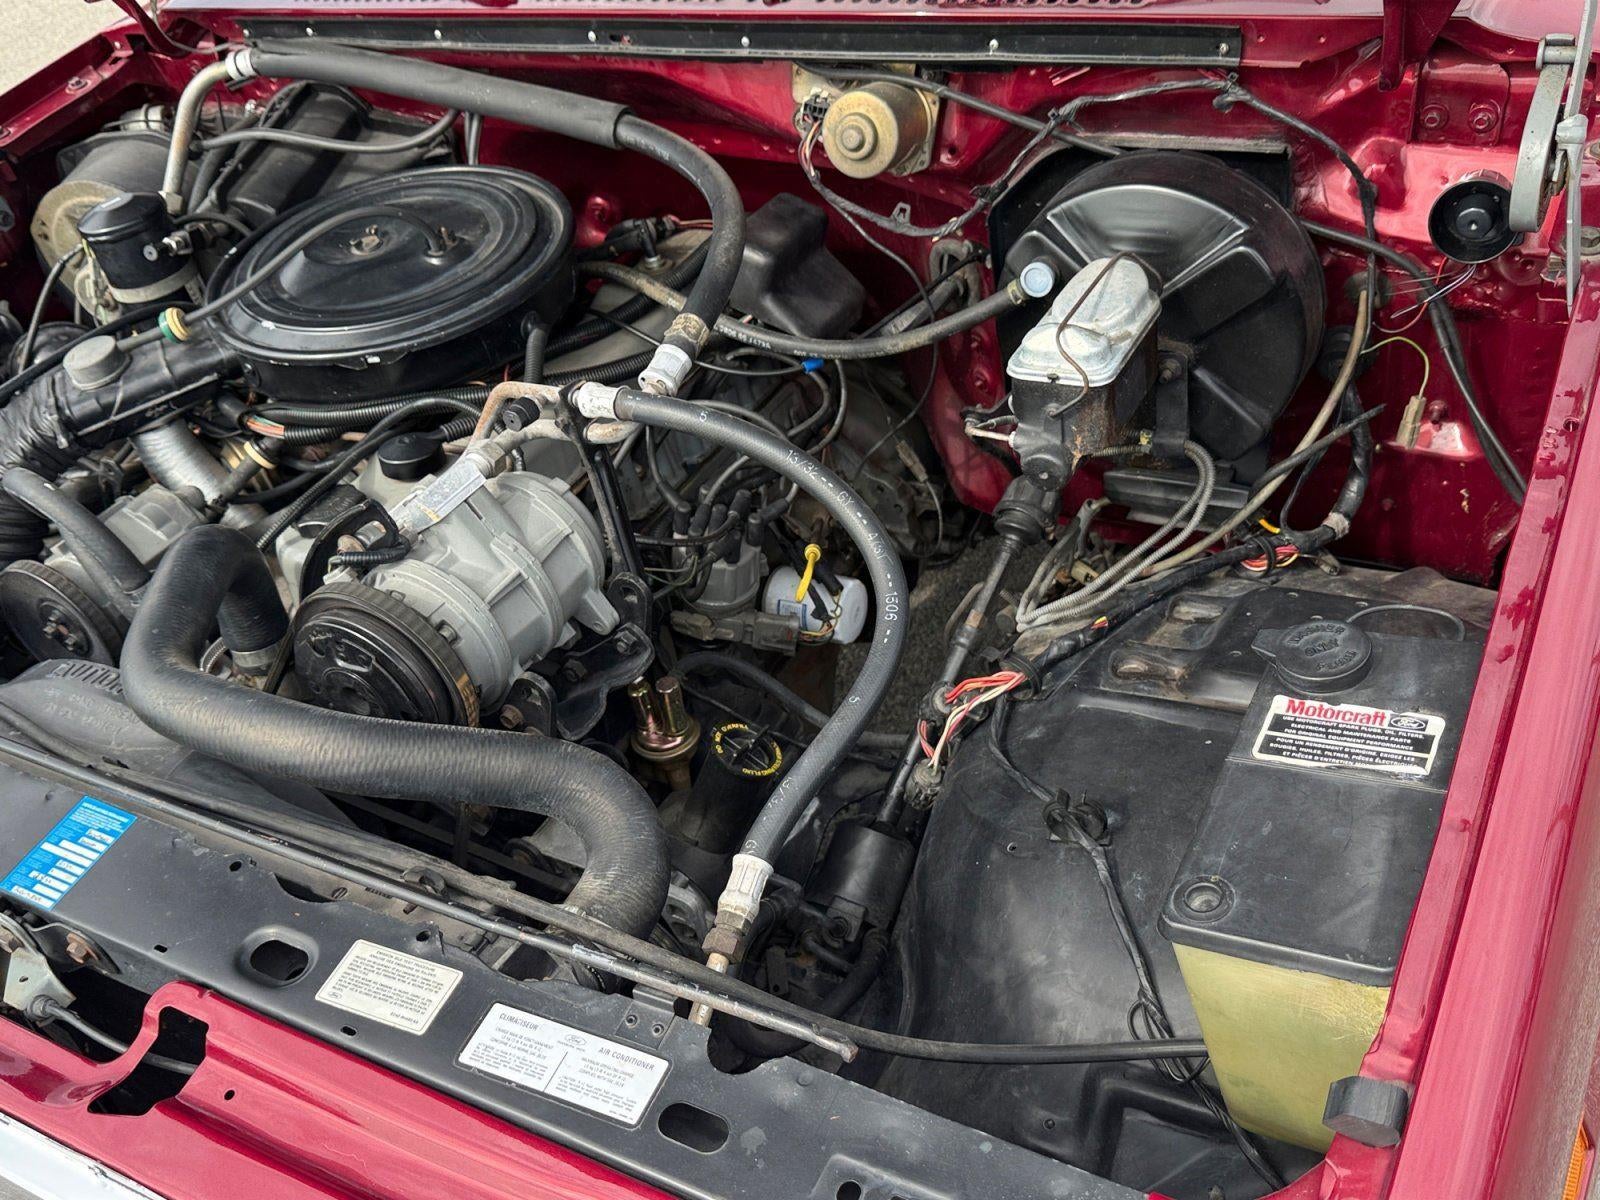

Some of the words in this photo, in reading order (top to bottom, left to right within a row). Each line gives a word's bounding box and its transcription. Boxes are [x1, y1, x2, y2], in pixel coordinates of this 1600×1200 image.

[884, 590, 899, 622] 1506
[1285, 699, 1387, 727] Motorcraft
[1296, 716, 1337, 727] MOTORCRAFT
[1339, 722, 1359, 730] SPARK
[1291, 722, 1326, 732] ELECTRICAL
[1343, 729, 1389, 741] MAINTENANCE
[1298, 729, 1327, 738] ORIGINAL
[1328, 733, 1364, 744] EQUIPMENT
[1366, 738, 1413, 750] PERFORMANCE
[1305, 741, 1343, 751] RENDEMENT
[598, 1047, 612, 1057] AIR
[611, 1051, 656, 1071] CONDITIONER
